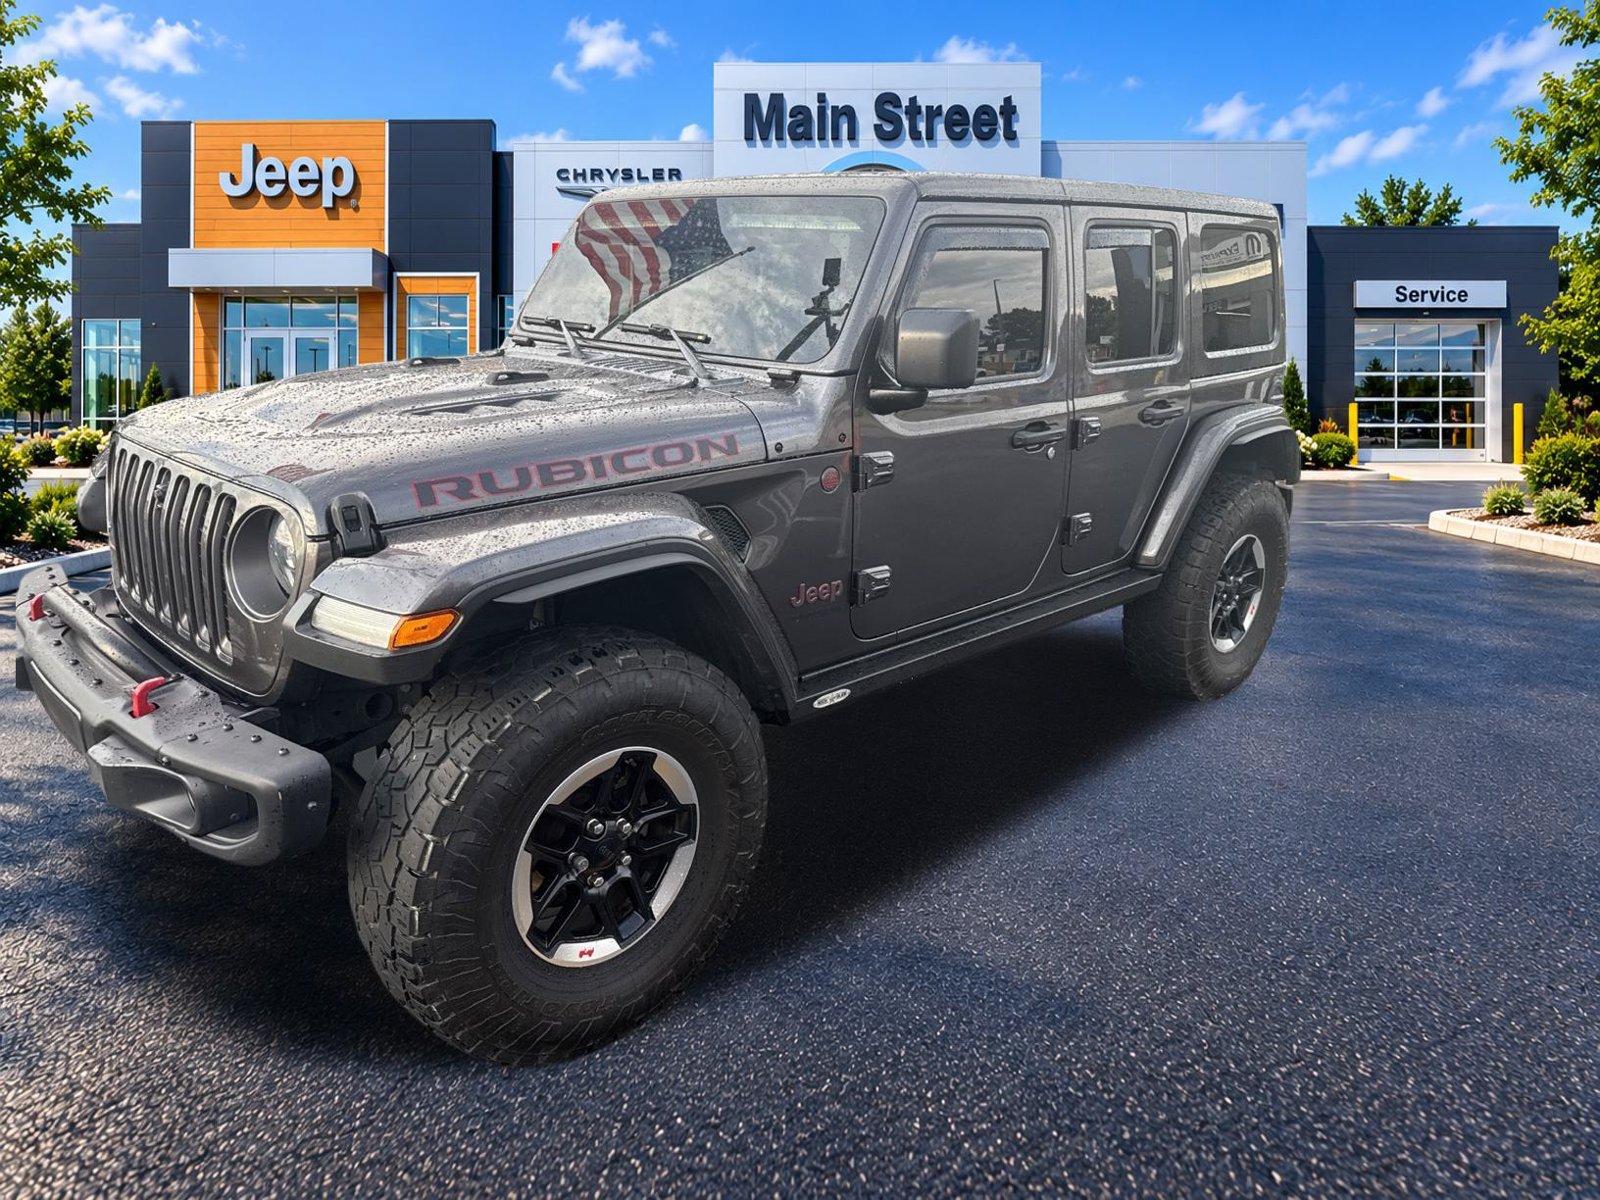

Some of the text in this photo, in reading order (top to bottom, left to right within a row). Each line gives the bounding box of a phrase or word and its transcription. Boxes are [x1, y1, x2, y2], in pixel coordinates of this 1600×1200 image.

[744, 91, 1018, 141] Main Street
[218, 143, 354, 208] Jeep
[556, 168, 682, 182] CHRYSLER
[1395, 285, 1468, 303] Service
[412, 433, 739, 509] RUBICON
[791, 580, 843, 607] Jeep
